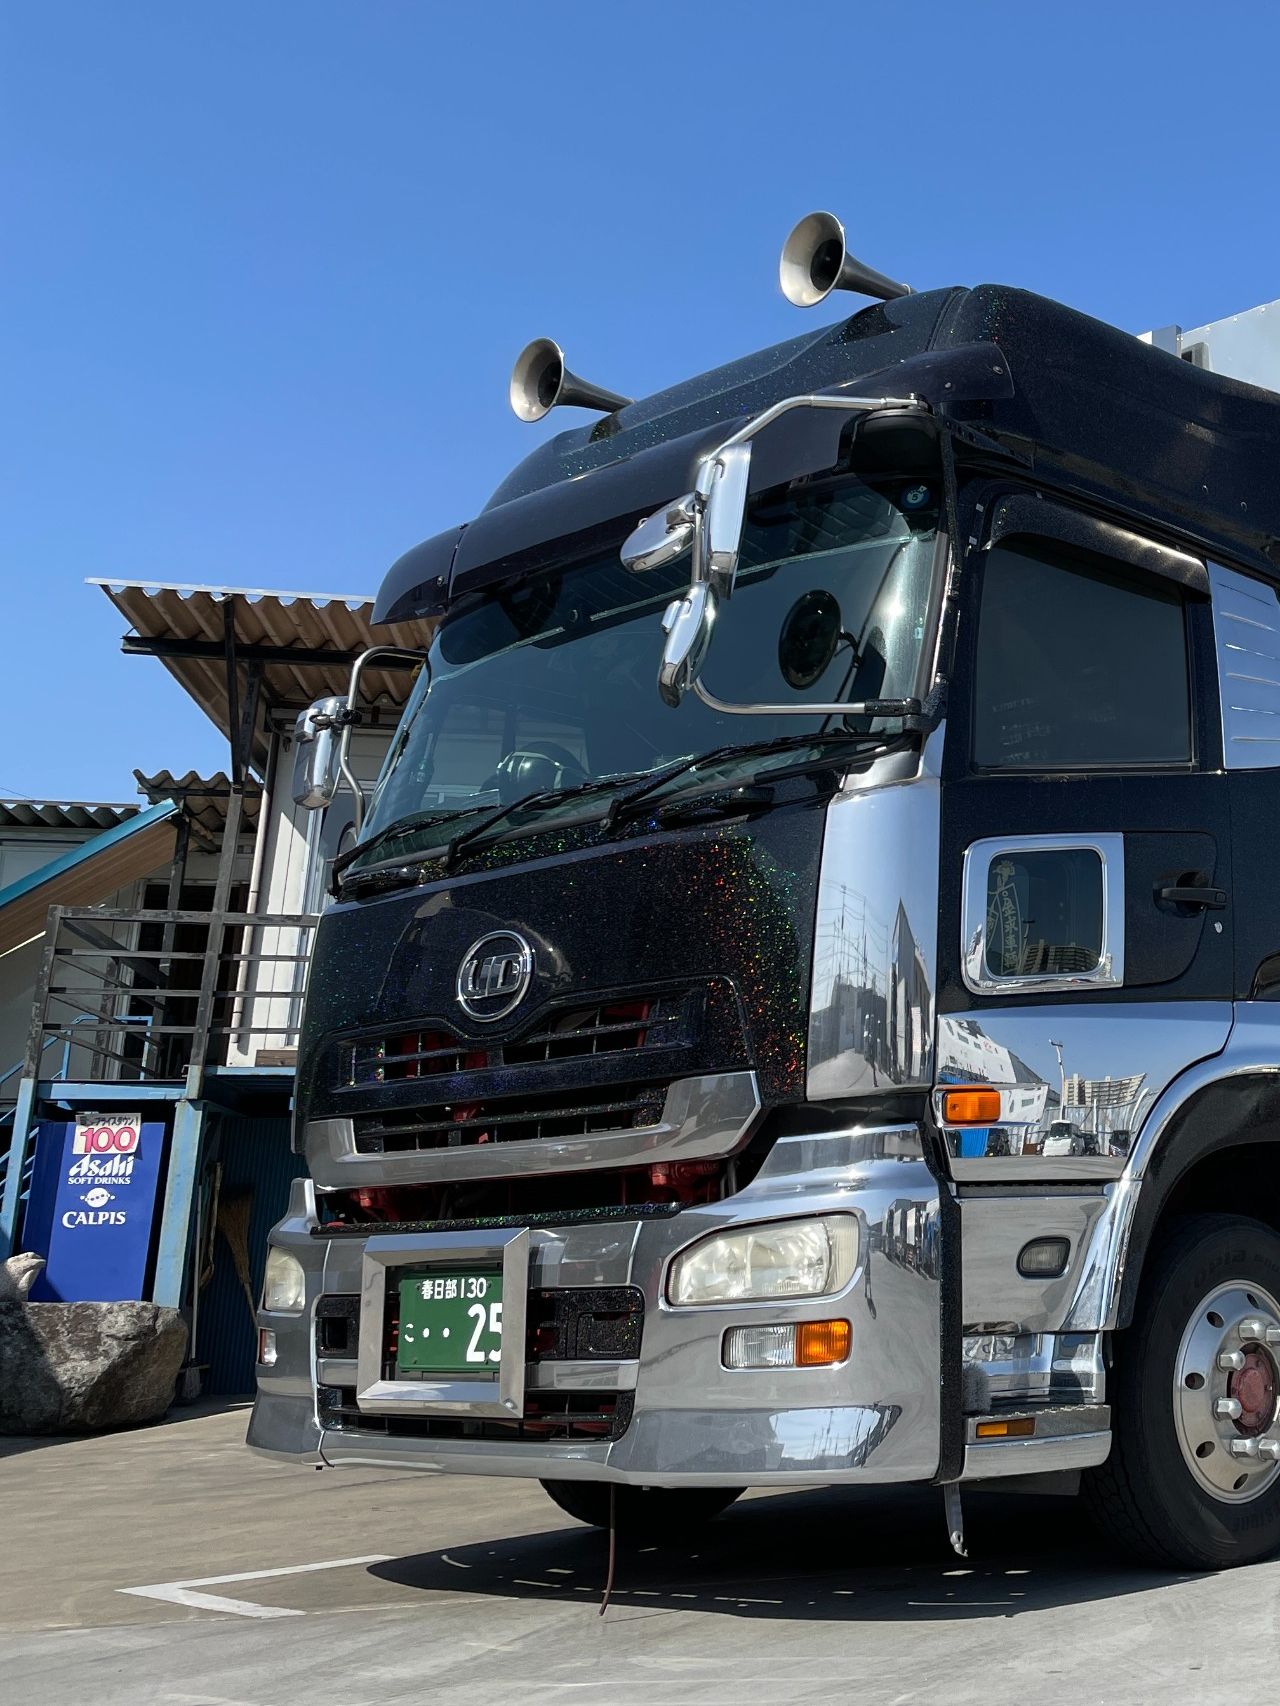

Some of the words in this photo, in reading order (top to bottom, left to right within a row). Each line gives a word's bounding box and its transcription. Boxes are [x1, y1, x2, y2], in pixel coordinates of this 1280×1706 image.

[463, 953, 522, 999] UD
[80, 1126, 136, 1153] 100
[69, 1154, 135, 1177] Asahi
[68, 1177, 93, 1185] SOFT
[94, 1176, 131, 1185] DRINKS
[62, 1211, 126, 1228] CALPIS
